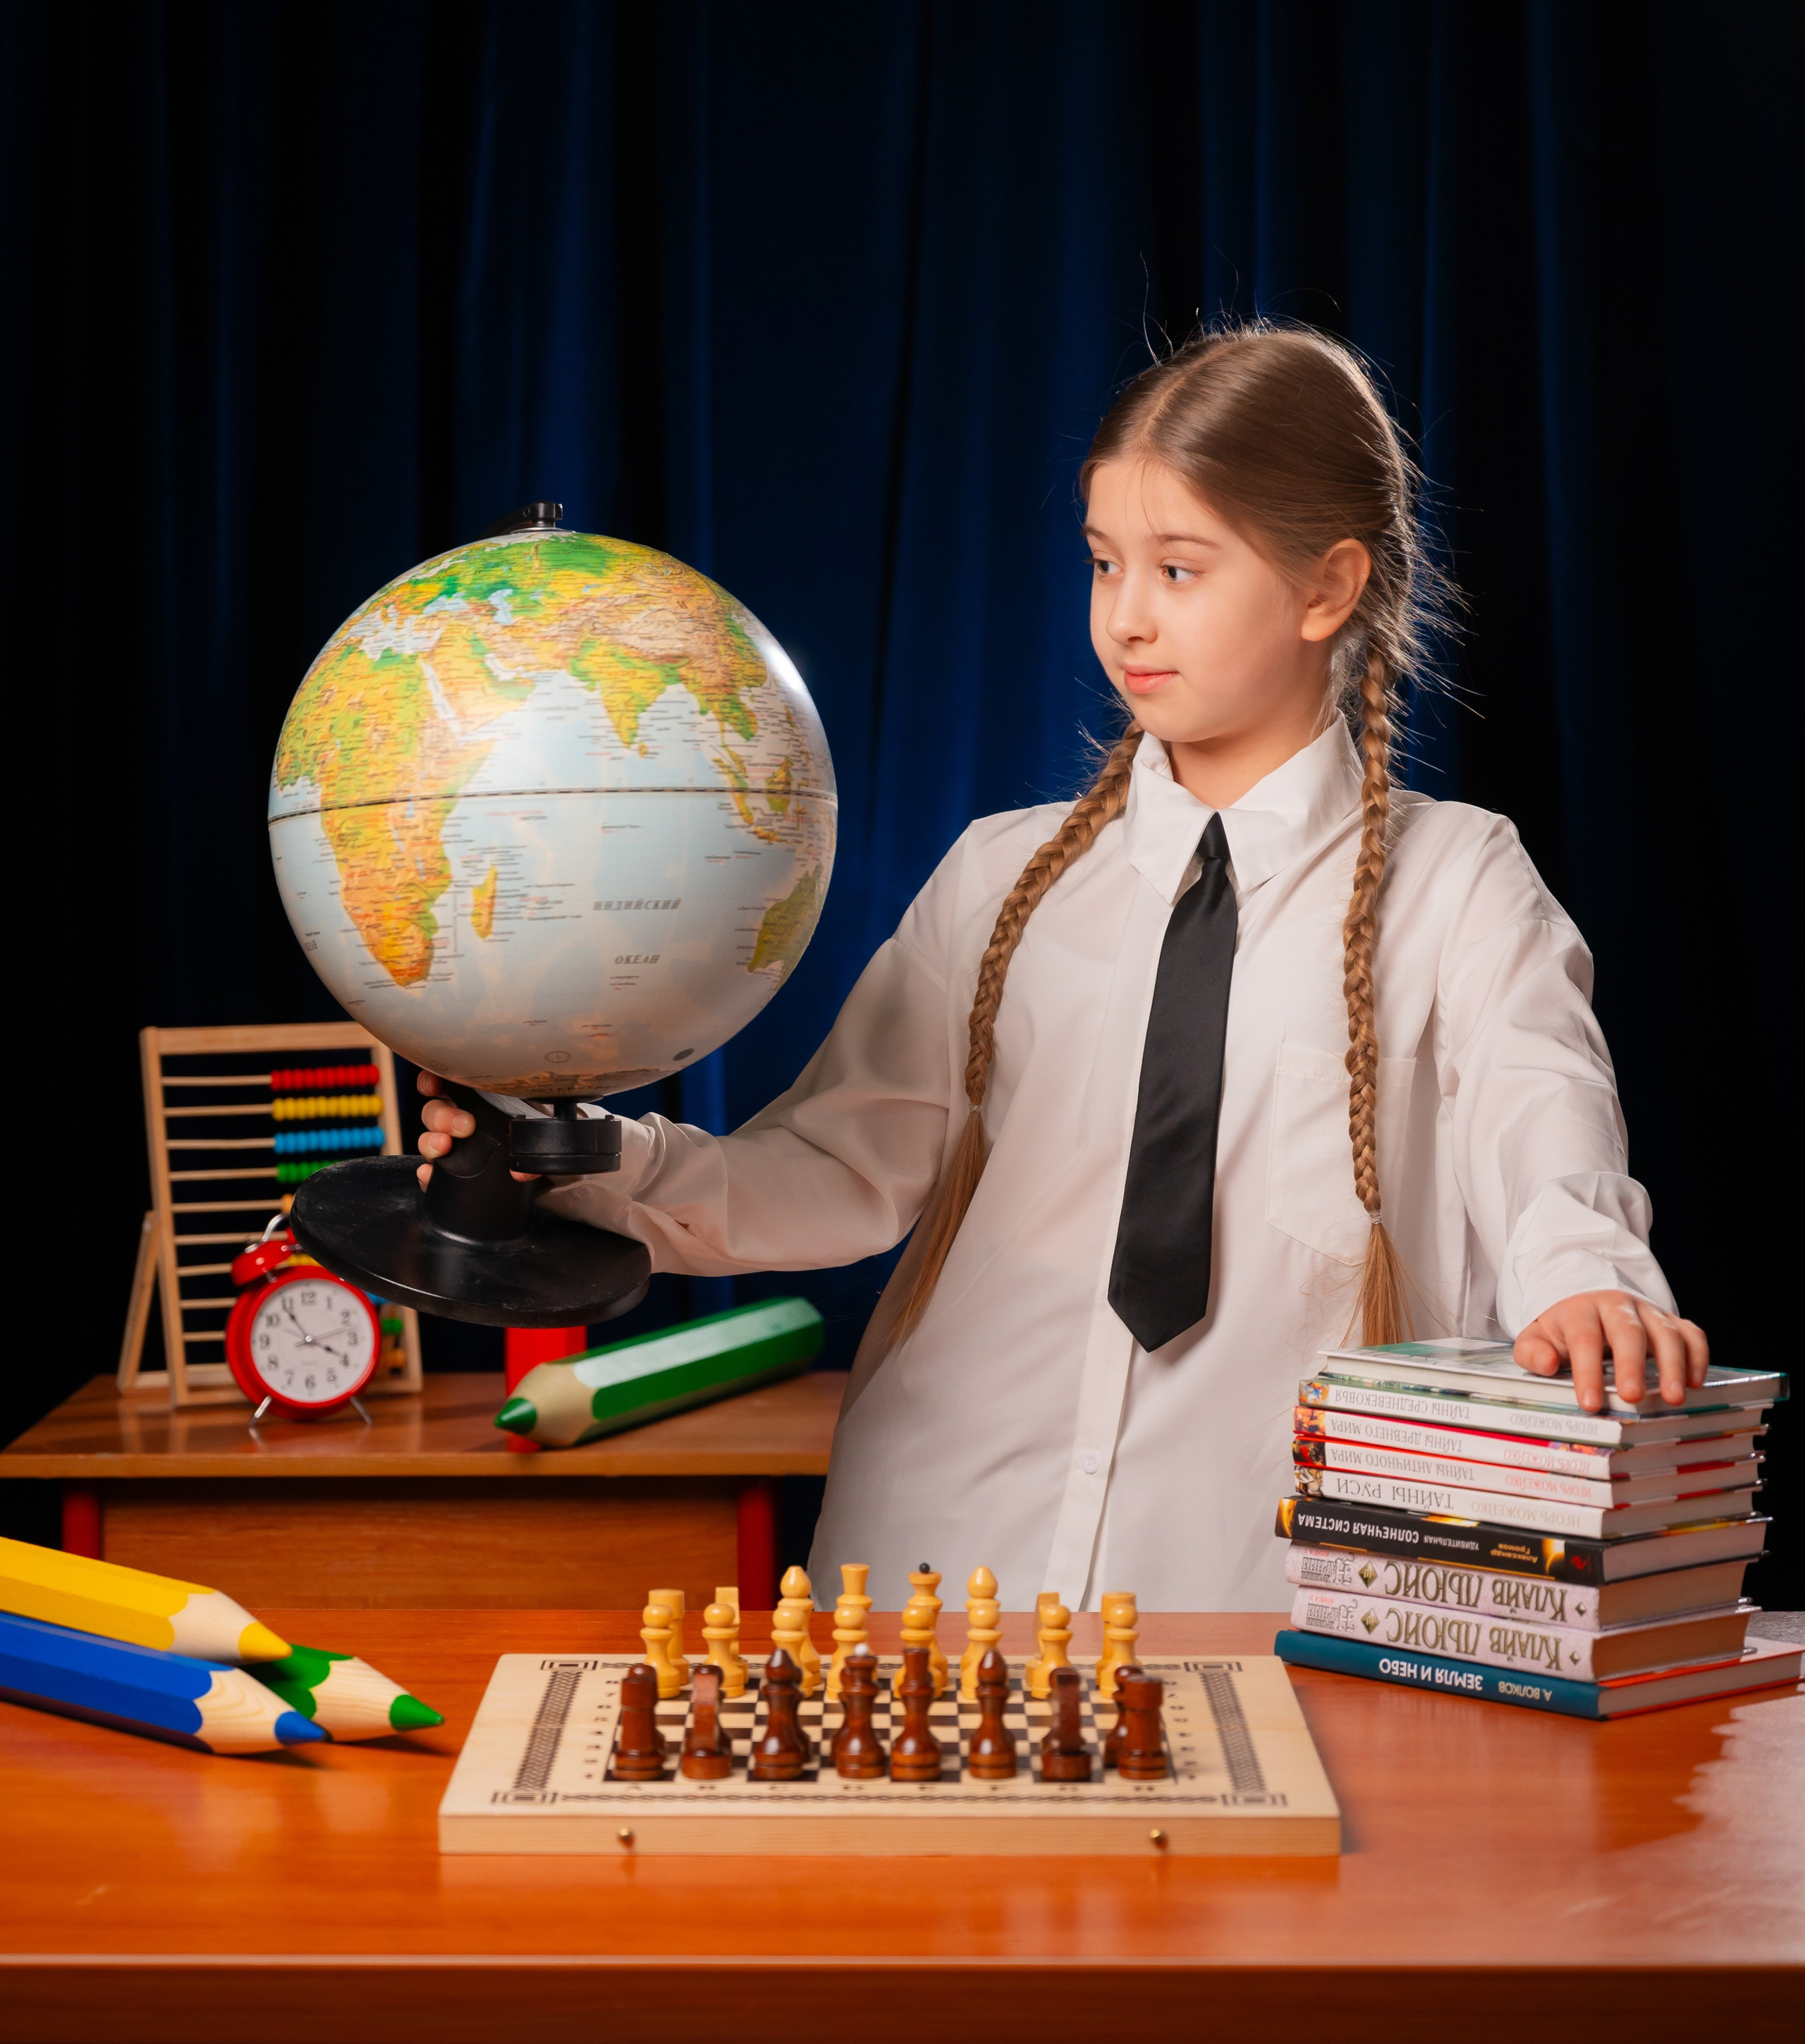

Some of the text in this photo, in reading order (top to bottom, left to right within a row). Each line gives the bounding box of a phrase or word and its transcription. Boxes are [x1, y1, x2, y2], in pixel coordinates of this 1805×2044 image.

[614, 954, 661, 965] ОКЕАН
[301, 1291, 315, 1306] 12
[326, 1296, 332, 1310] 1
[266, 1313, 279, 1328] 10
[341, 1310, 350, 1325] 2
[259, 1332, 271, 1350] 9
[348, 1330, 358, 1346] 3
[267, 1355, 279, 1372] 8
[340, 1352, 349, 1368] 4
[284, 1369, 295, 1385] 7
[305, 1373, 316, 1390] 6
[326, 1366, 337, 1383] 5
[1335, 1389, 1470, 1420] ТАЙНЫ СРЕДНЕВЕКОВЬЯ
[1510, 1413, 1598, 1436] ИГОРЬ МОЖЕЙКО
[1330, 1419, 1463, 1454] ТАЙНЫ ДРЕВНЕГО МИРА
[1330, 1448, 1474, 1482] ТАЙНЫ АНТИЧНОГО МИРА
[1504, 1448, 1590, 1474] ИГОРЬ МОЖЕЙКО
[1336, 1478, 1454, 1510] ТАЙНЫ РУСИ
[1505, 1474, 1591, 1499] ИГОРЬ МОЖЕЙКО
[1471, 1500, 1580, 1528] ИГОРЬ МОЖЕЙКО
[1297, 1513, 1479, 1551] УДИВИТЕЛЬНАЯ СОЛНЕЧНАЯ СИСТЕМА
[1490, 1548, 1538, 1564] Александр
[1497, 1543, 1531, 1555] Громов
[1300, 1570, 1331, 1584] ХРОНИКИ
[1383, 1560, 1483, 1608] ЛЬЮИС
[1306, 1617, 1335, 1631] ХРОНИКИ
[1385, 1608, 1481, 1656] ЛЬЮИС
[1379, 1658, 1483, 1691] ЗЕМЛЯ И НЕБО
[1498, 1681, 1553, 1701] А. ВОЛКОВ
